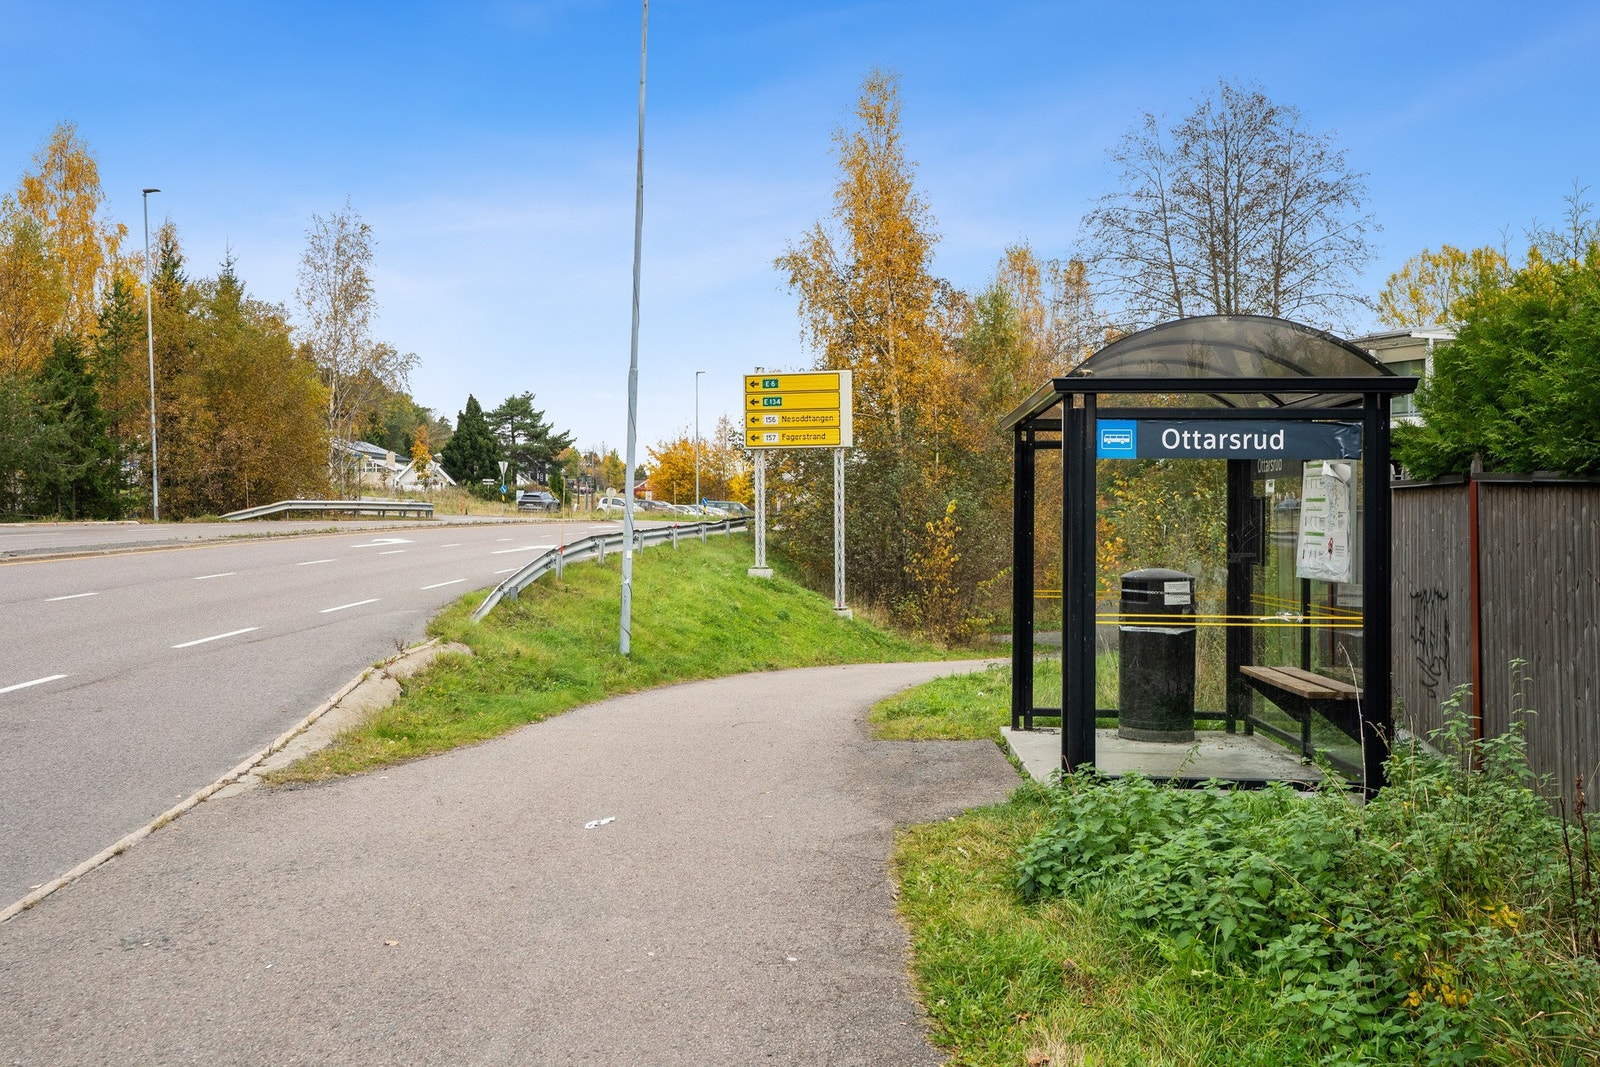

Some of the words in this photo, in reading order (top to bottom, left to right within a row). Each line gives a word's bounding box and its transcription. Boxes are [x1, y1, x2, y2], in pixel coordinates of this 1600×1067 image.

[781, 415, 834, 423] Nesoddtangen
[781, 433, 826, 442] Fagerstrand
[1161, 428, 1285, 450] Ottarsrud
